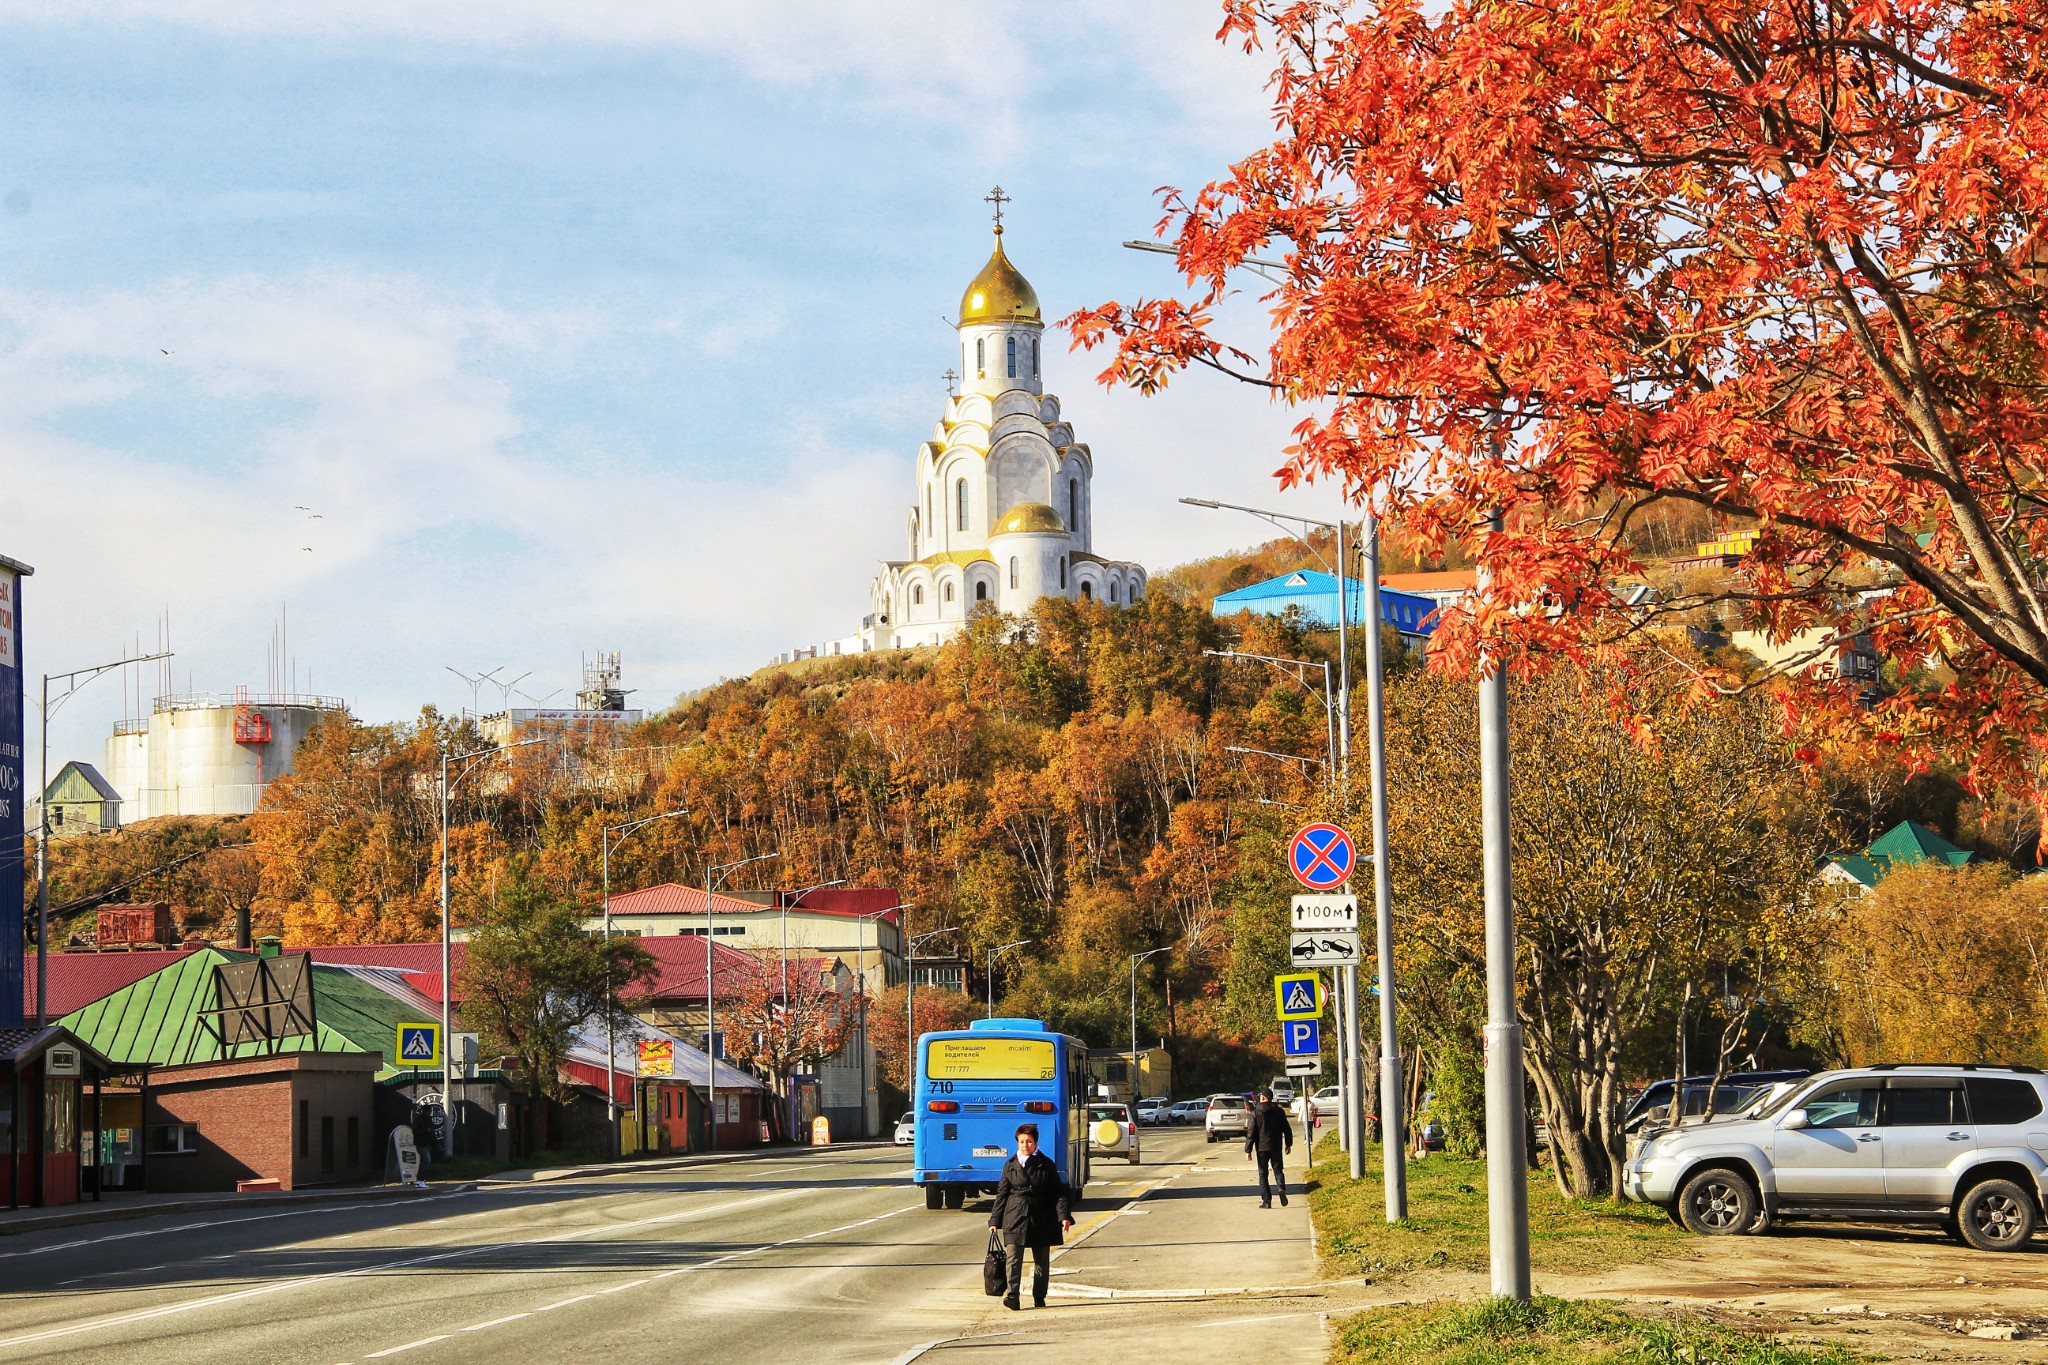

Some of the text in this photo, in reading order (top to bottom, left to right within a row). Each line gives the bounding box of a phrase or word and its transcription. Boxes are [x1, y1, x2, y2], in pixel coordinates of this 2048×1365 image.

[1293, 1023, 1311, 1051] P
[945, 1044, 985, 1052] Приглашаем
[1042, 1070, 1053, 1079] 26
[930, 1081, 953, 1094] 710
